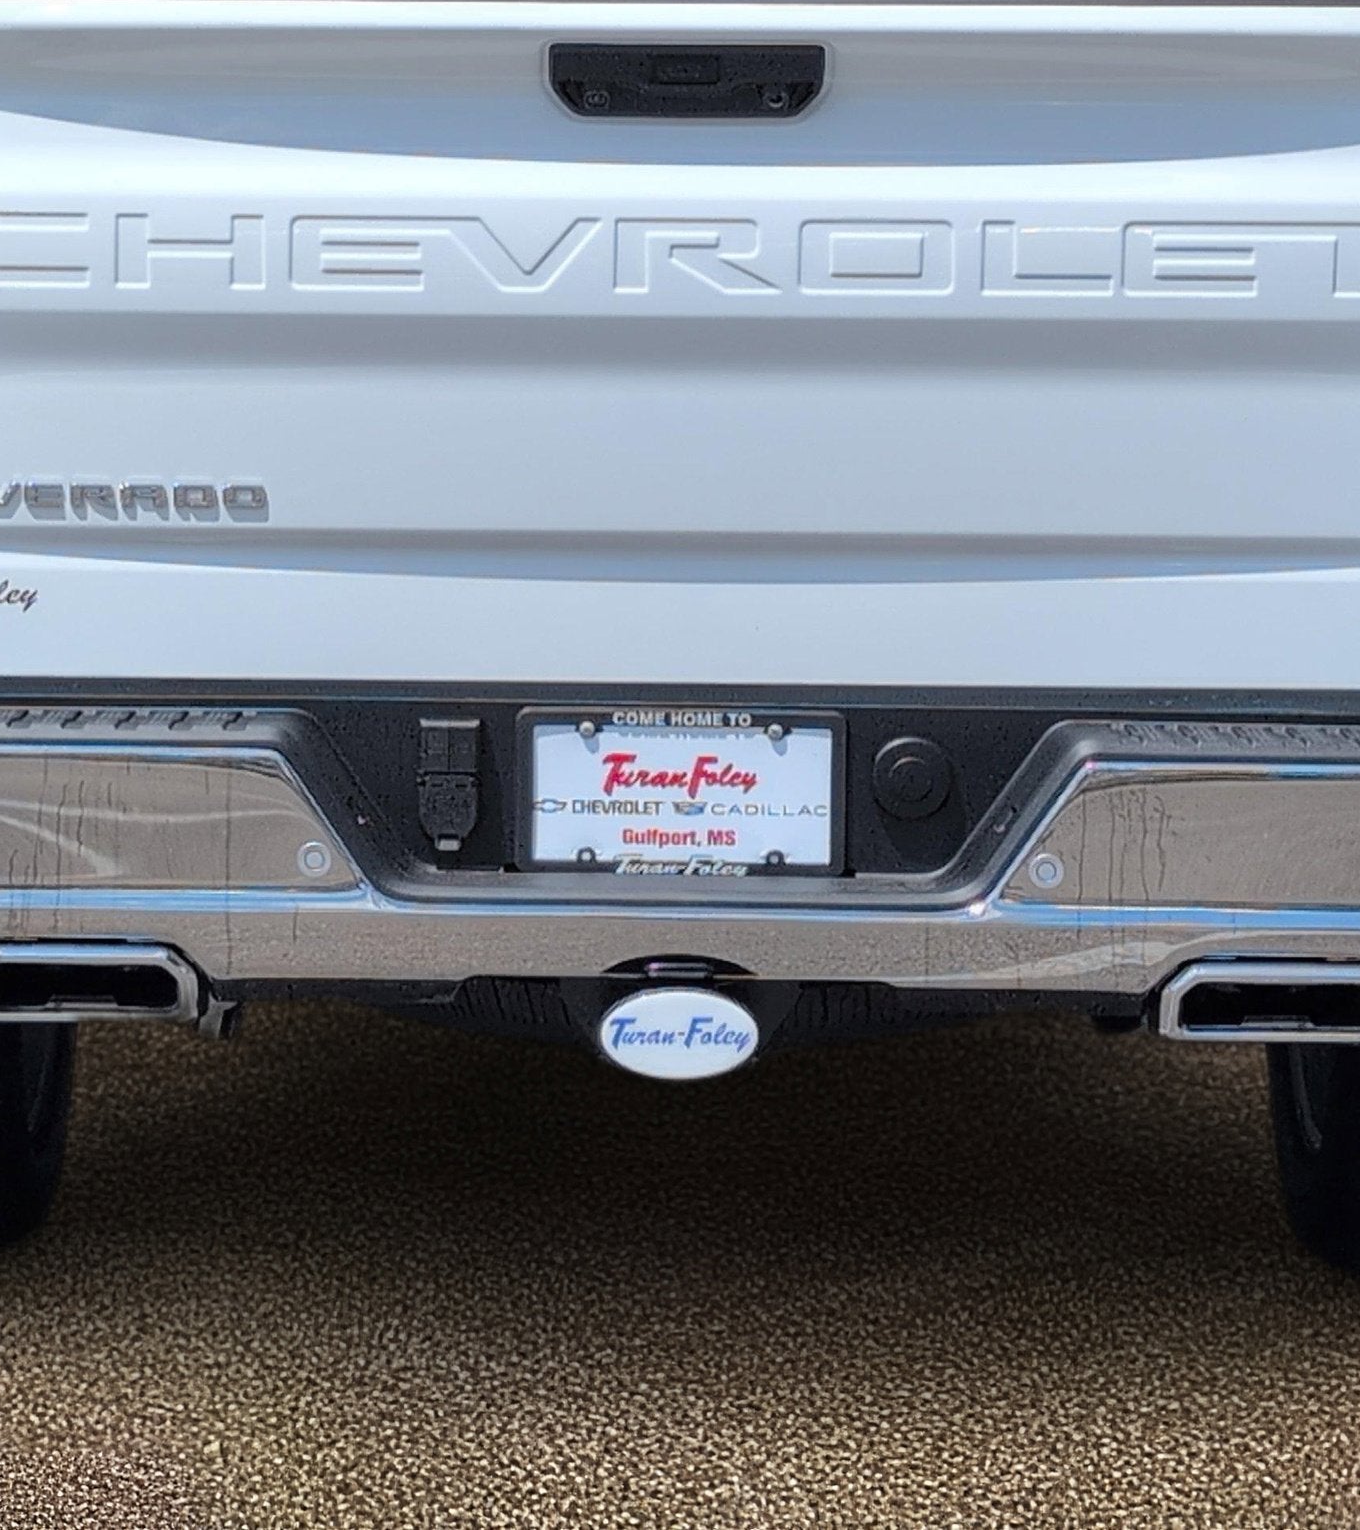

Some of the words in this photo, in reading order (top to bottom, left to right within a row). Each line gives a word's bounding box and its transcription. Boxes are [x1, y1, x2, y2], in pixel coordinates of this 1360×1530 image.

[612, 711, 666, 726] COME
[671, 712, 723, 727] HOME
[728, 713, 752, 727] TO
[688, 756, 757, 800] Foley
[572, 800, 663, 816] CHEVROLET
[711, 803, 828, 817] CADILLAC
[622, 828, 702, 849] Gulfport,
[707, 830, 736, 846] MS
[610, 1017, 752, 1052] Turan-Foley
